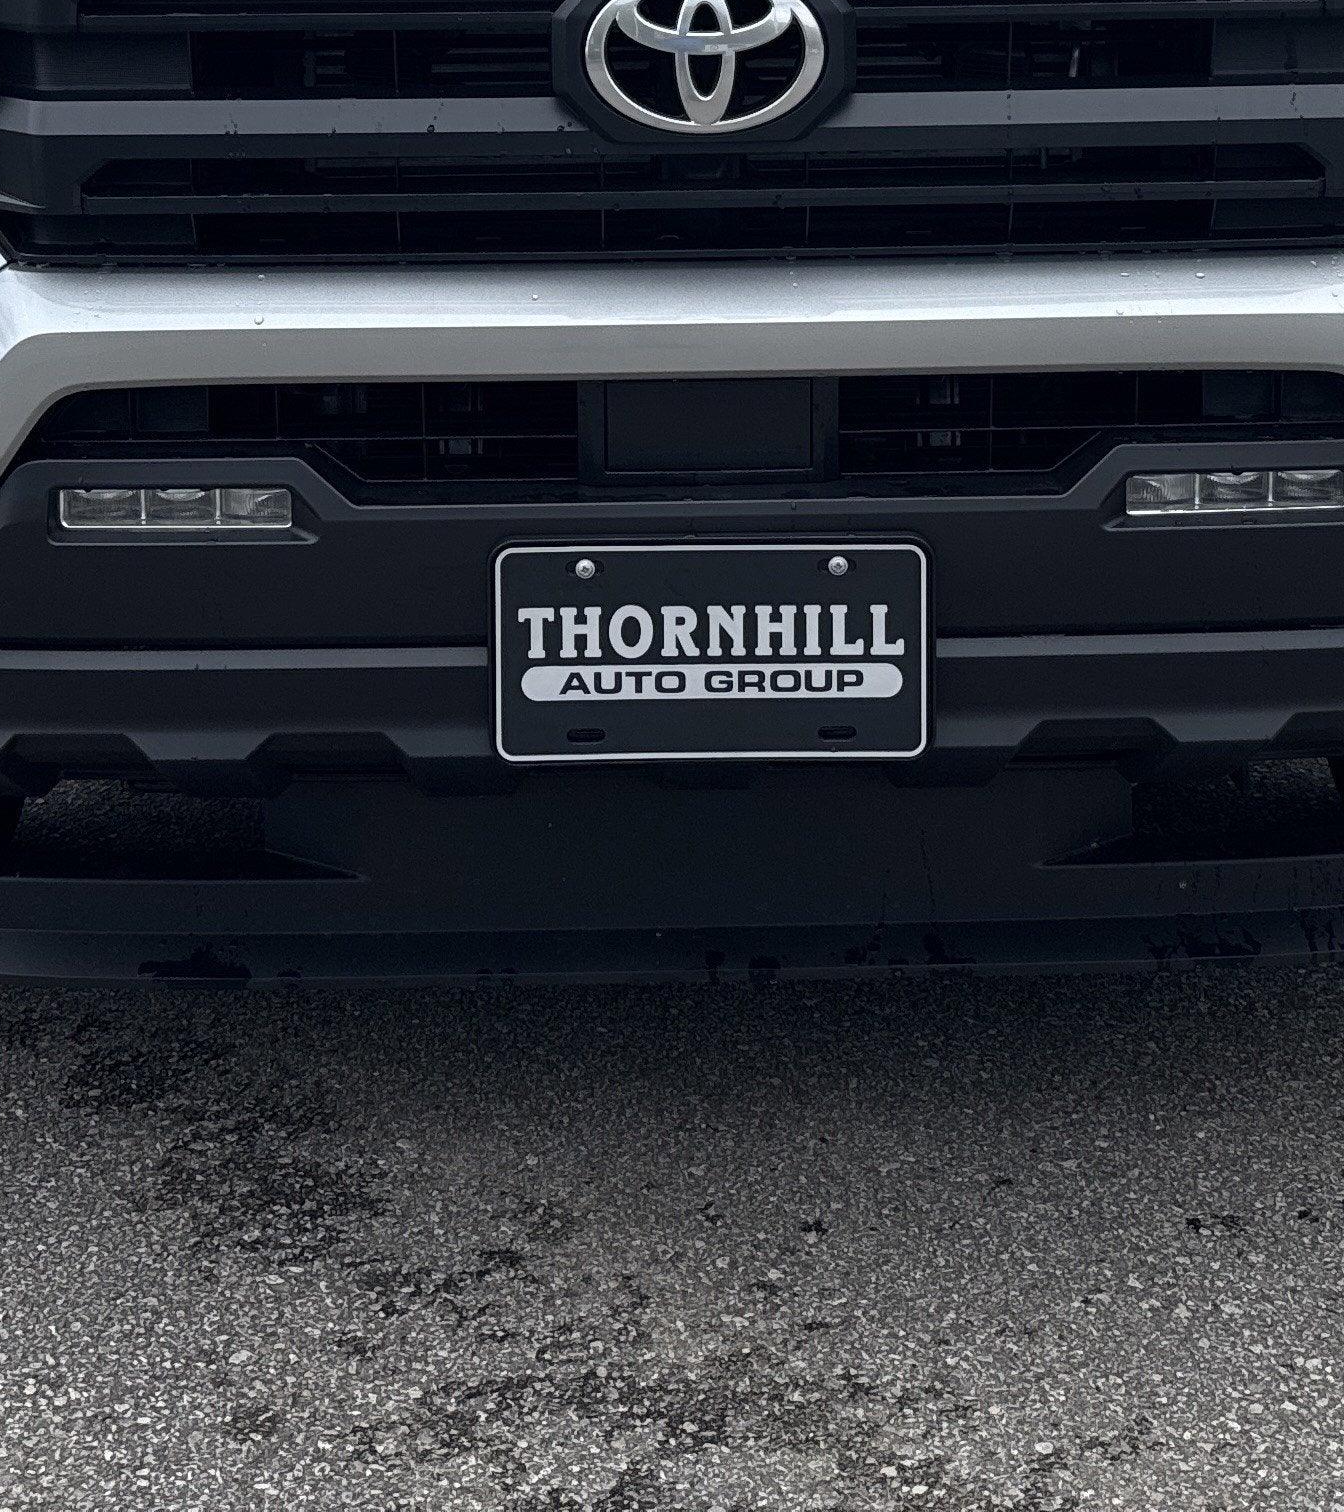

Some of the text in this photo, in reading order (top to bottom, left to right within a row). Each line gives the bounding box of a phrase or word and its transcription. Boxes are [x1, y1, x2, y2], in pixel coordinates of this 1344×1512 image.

[518, 604, 905, 659] THORNHILL
[559, 668, 864, 695] AUTO GROUP
